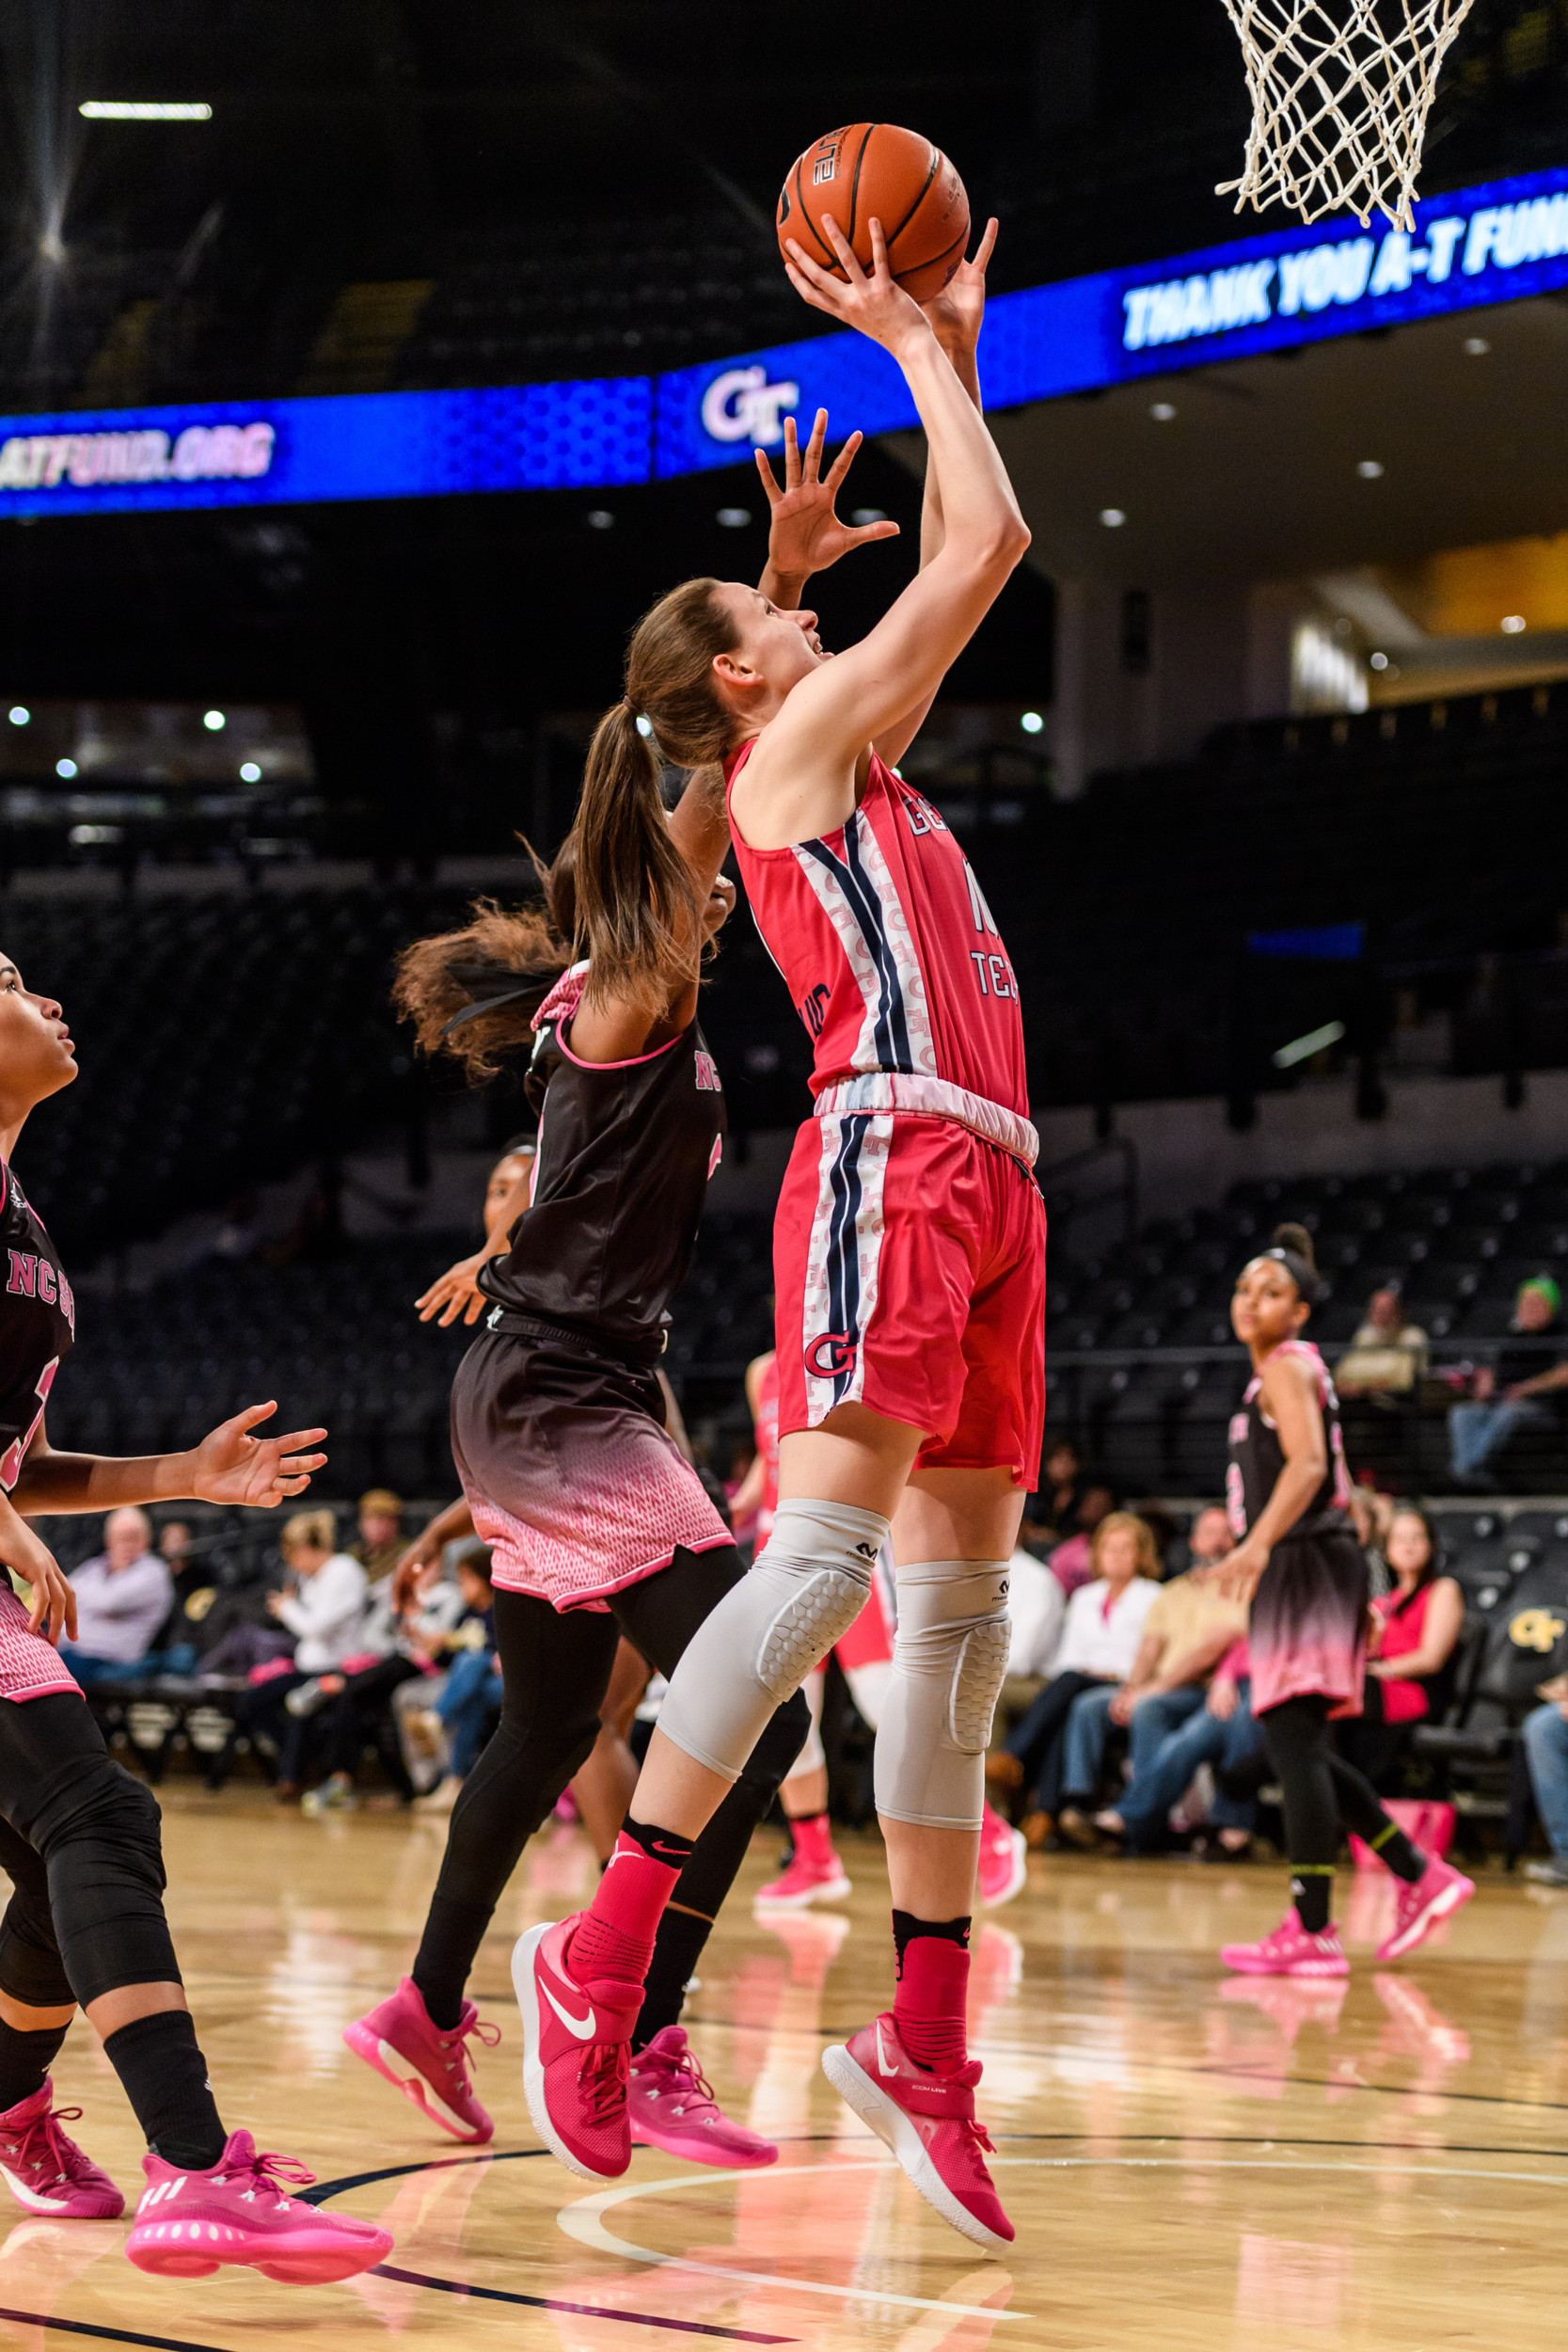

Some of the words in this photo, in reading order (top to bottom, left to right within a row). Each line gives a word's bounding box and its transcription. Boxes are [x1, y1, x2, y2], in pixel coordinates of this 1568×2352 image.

[1122, 258, 1277, 351] THANK
[1276, 236, 1375, 316] YOU
[1369, 215, 1467, 297] A-T
[1461, 191, 1568, 276] FUN
